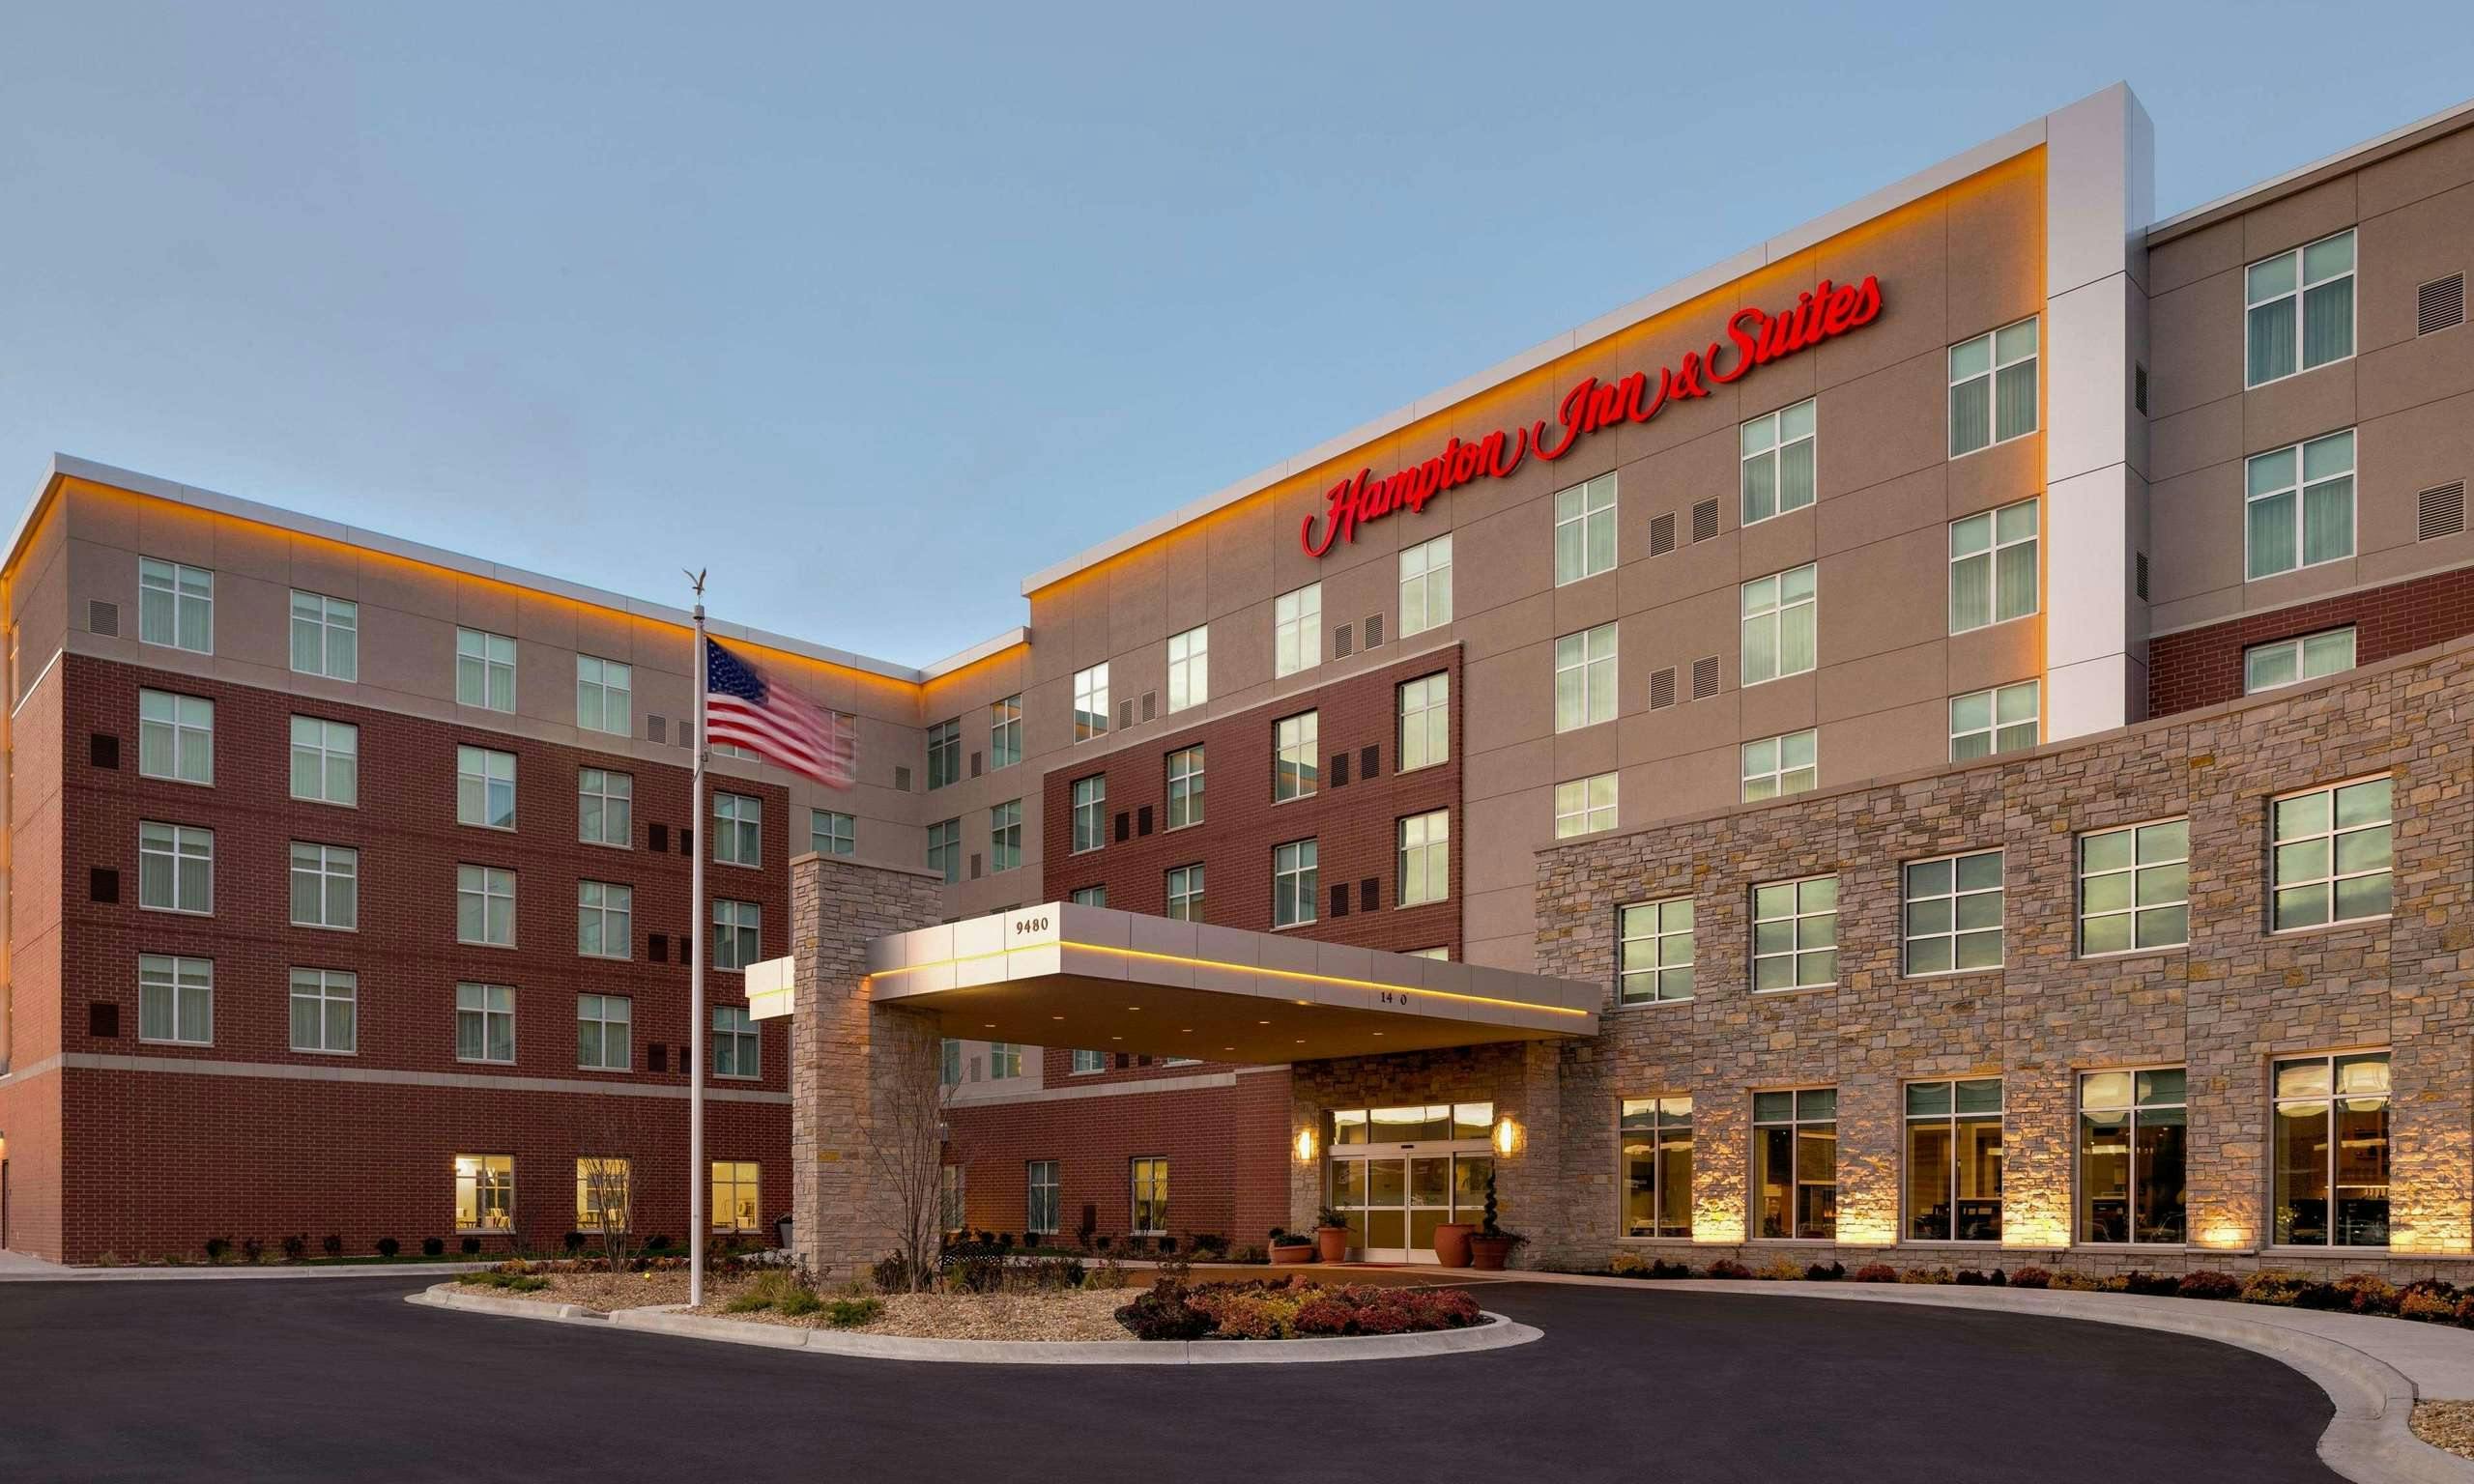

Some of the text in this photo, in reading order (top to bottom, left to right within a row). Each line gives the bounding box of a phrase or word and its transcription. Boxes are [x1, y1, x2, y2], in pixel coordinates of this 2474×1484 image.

[1300, 274, 1884, 557] Hampton Inn & Suites
[1016, 917, 1049, 935] 9480
